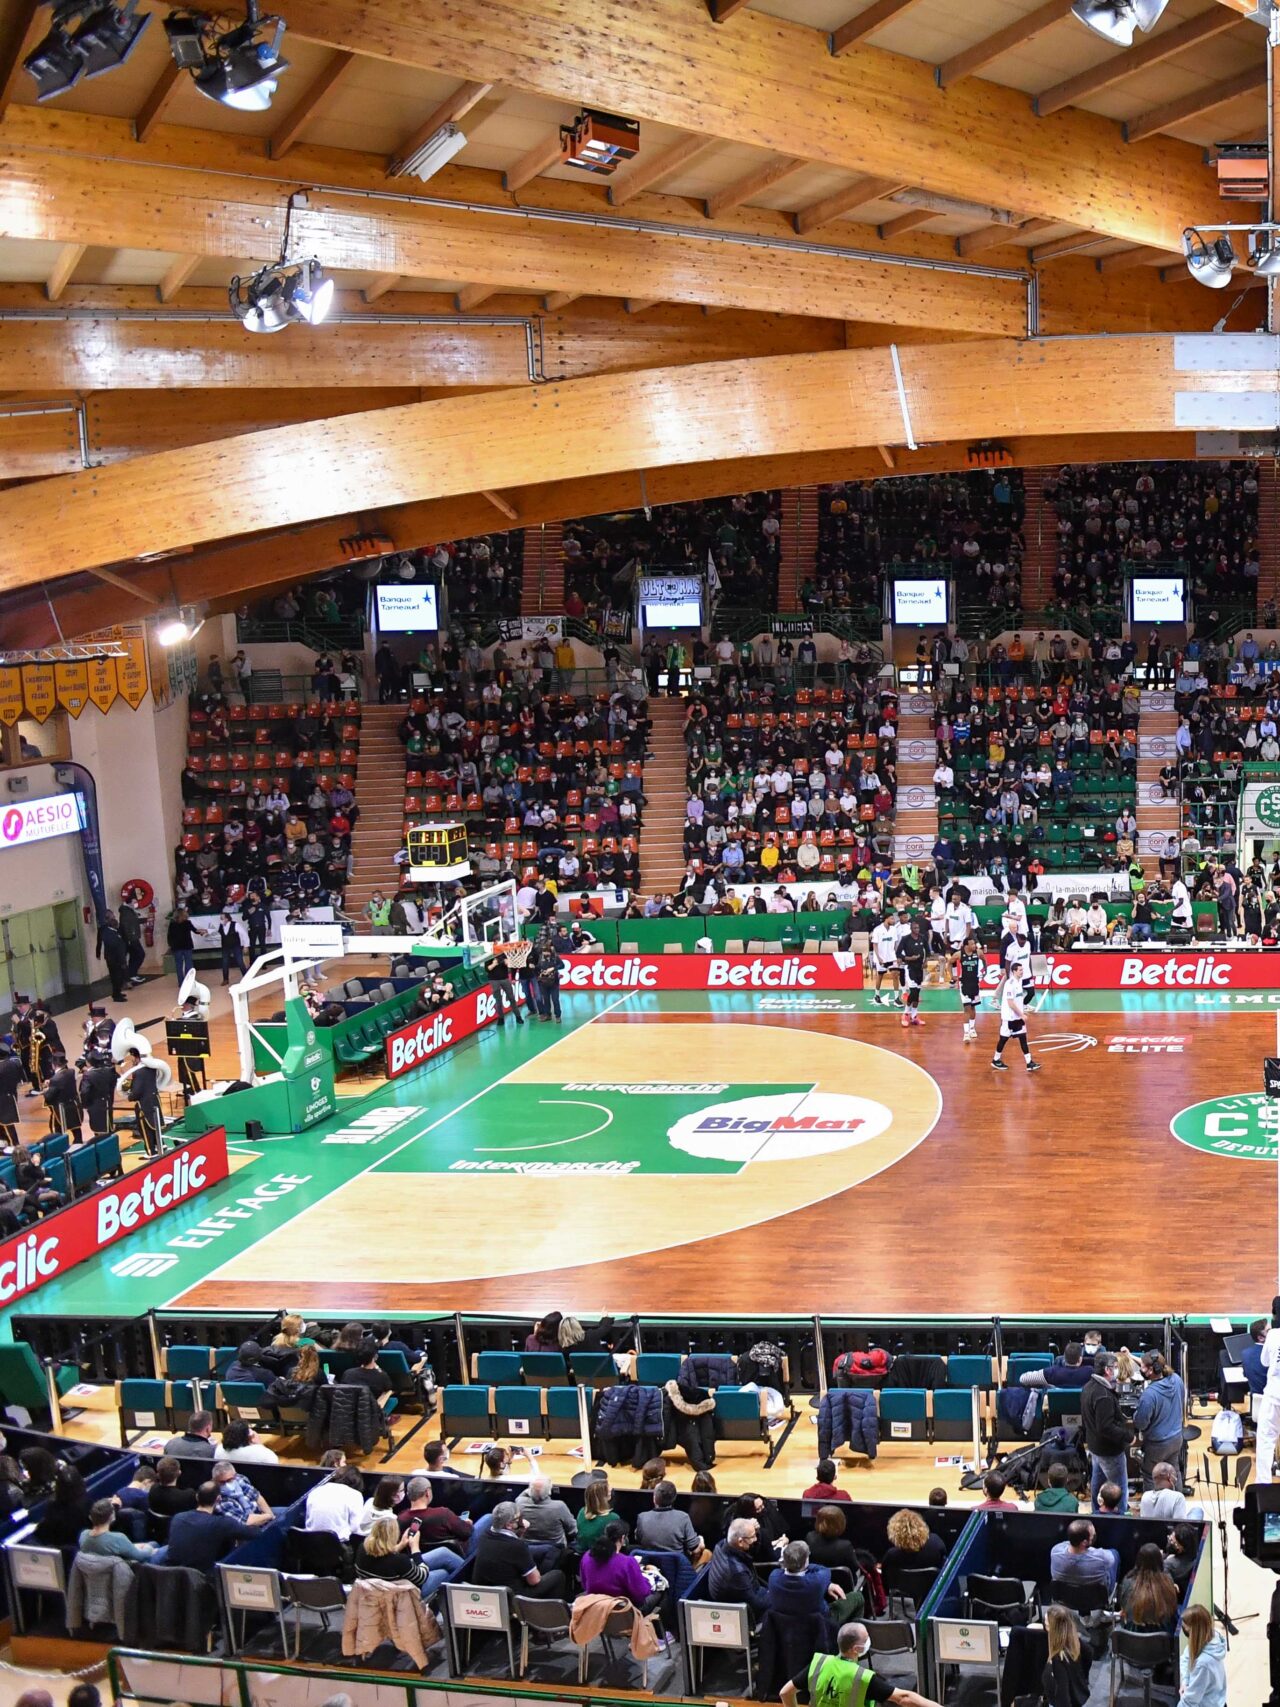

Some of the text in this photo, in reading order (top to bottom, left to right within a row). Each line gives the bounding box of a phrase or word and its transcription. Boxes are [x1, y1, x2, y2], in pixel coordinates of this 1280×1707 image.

[908, 746, 926, 754] cora
[1149, 742, 1167, 750] cora
[25, 821, 71, 838] MUTUELLE
[558, 957, 659, 986] Betclic
[707, 957, 818, 986] Betclic
[1120, 956, 1232, 985] Betclic
[391, 1013, 453, 1073] Betclic
[1107, 1043, 1185, 1053] ÉLITE
[1110, 1036, 1189, 1044] Betclic
[561, 1082, 730, 1095] Intermarché
[306, 1096, 328, 1113] LIMOGES
[314, 1104, 332, 1119] sportive
[693, 1115, 866, 1133] BigMat
[448, 1159, 641, 1175] Intermarché
[97, 1151, 207, 1244] Betclic
[167, 1173, 312, 1248] EIFFAGE
[465, 1607, 489, 1617] SMAC
